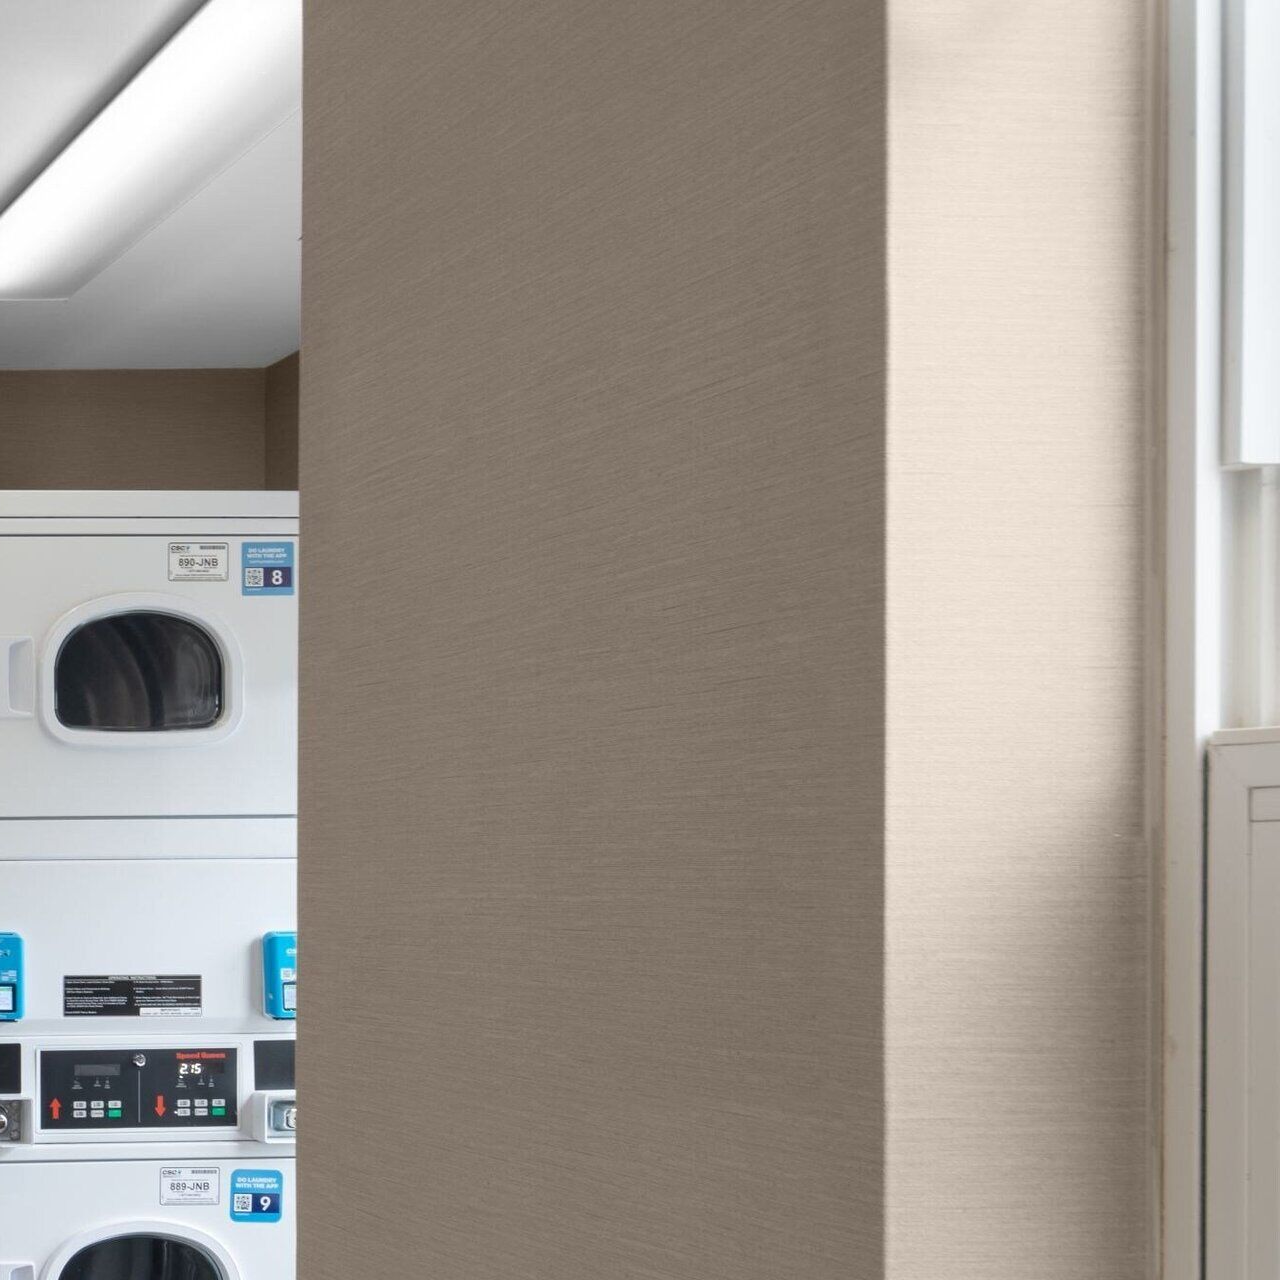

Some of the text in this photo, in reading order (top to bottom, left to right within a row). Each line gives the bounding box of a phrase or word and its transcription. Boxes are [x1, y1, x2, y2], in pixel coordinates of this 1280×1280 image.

[178, 558, 219, 567] 890-JNB
[271, 570, 283, 585] 8
[170, 1182, 210, 1191] 889-JNB
[260, 1196, 272, 1211] 9
